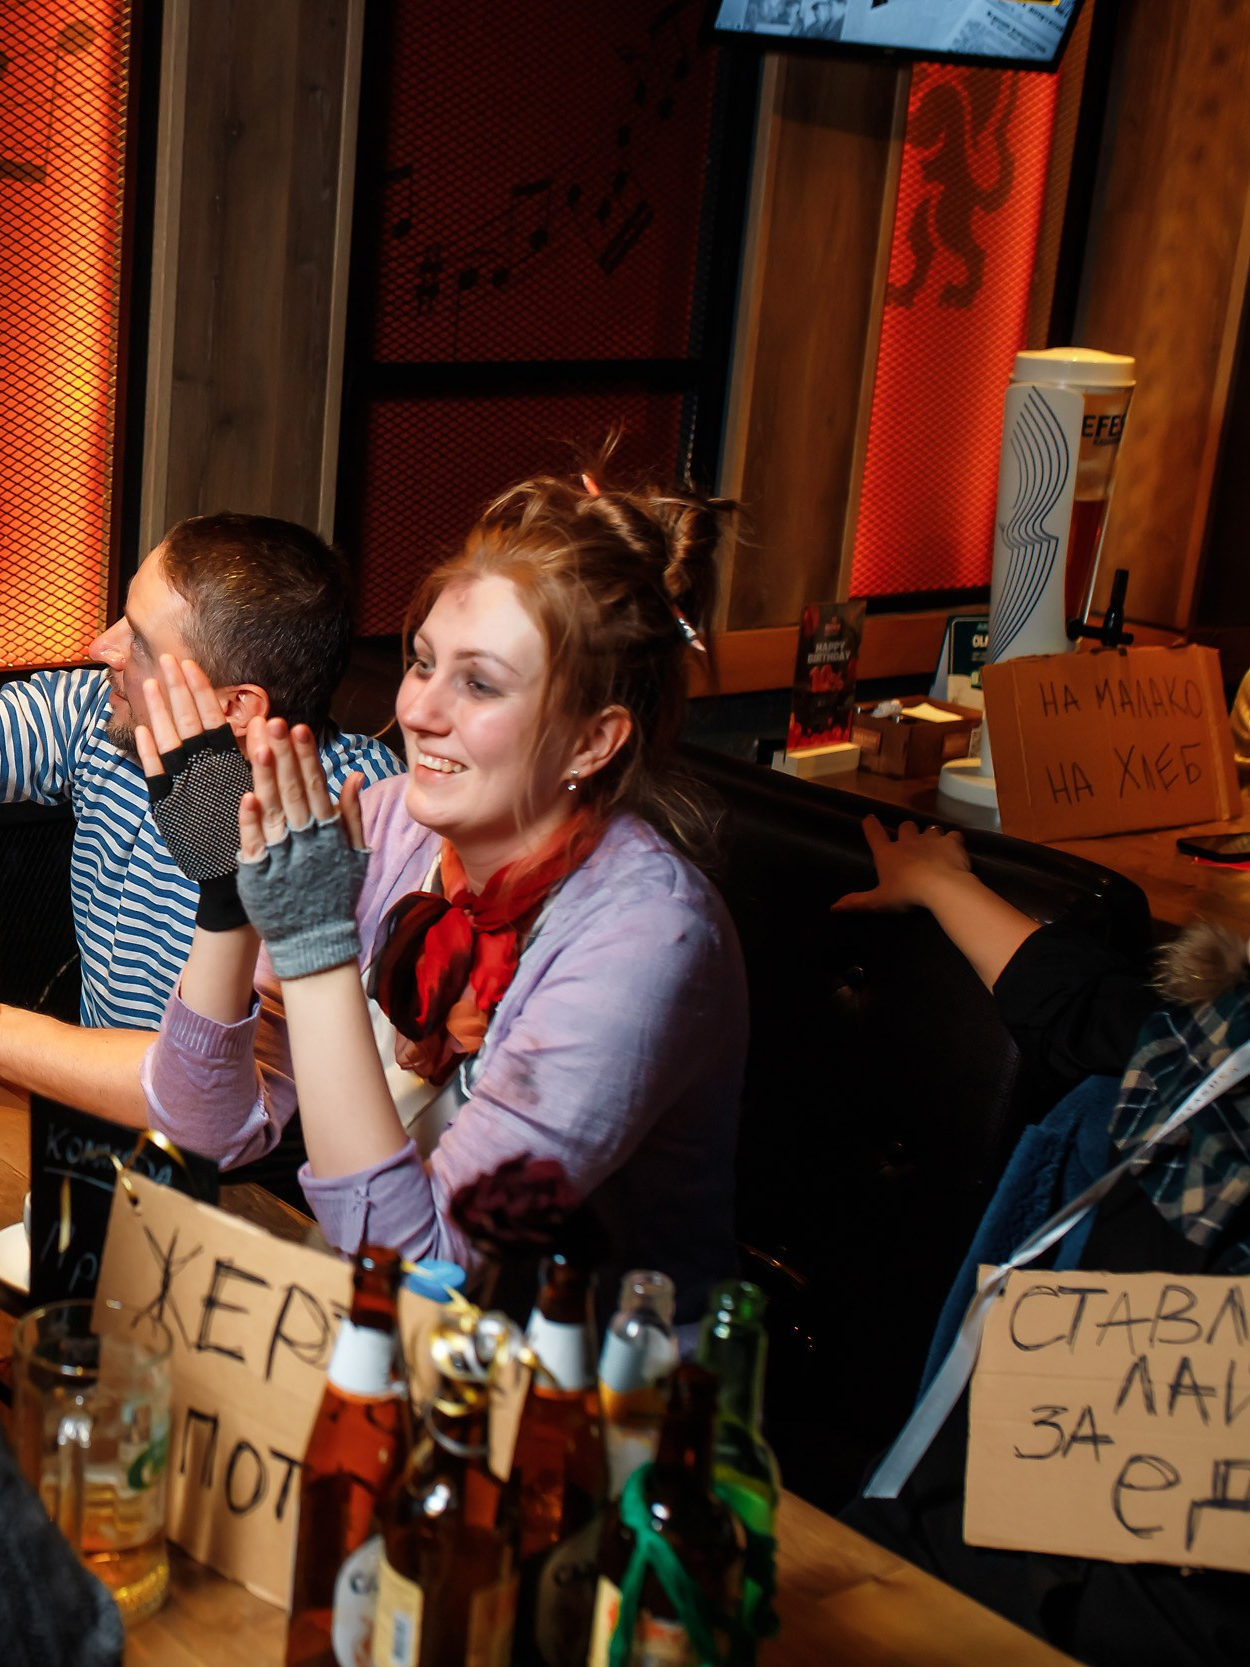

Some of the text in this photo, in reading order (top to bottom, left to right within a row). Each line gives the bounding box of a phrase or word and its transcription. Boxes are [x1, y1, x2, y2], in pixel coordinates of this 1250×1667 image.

[1039, 675, 1202, 719] НА МАЛАКО
[1046, 742, 1202, 805] НА ХЛЕБ
[1014, 1405, 1115, 1463] ЗА
